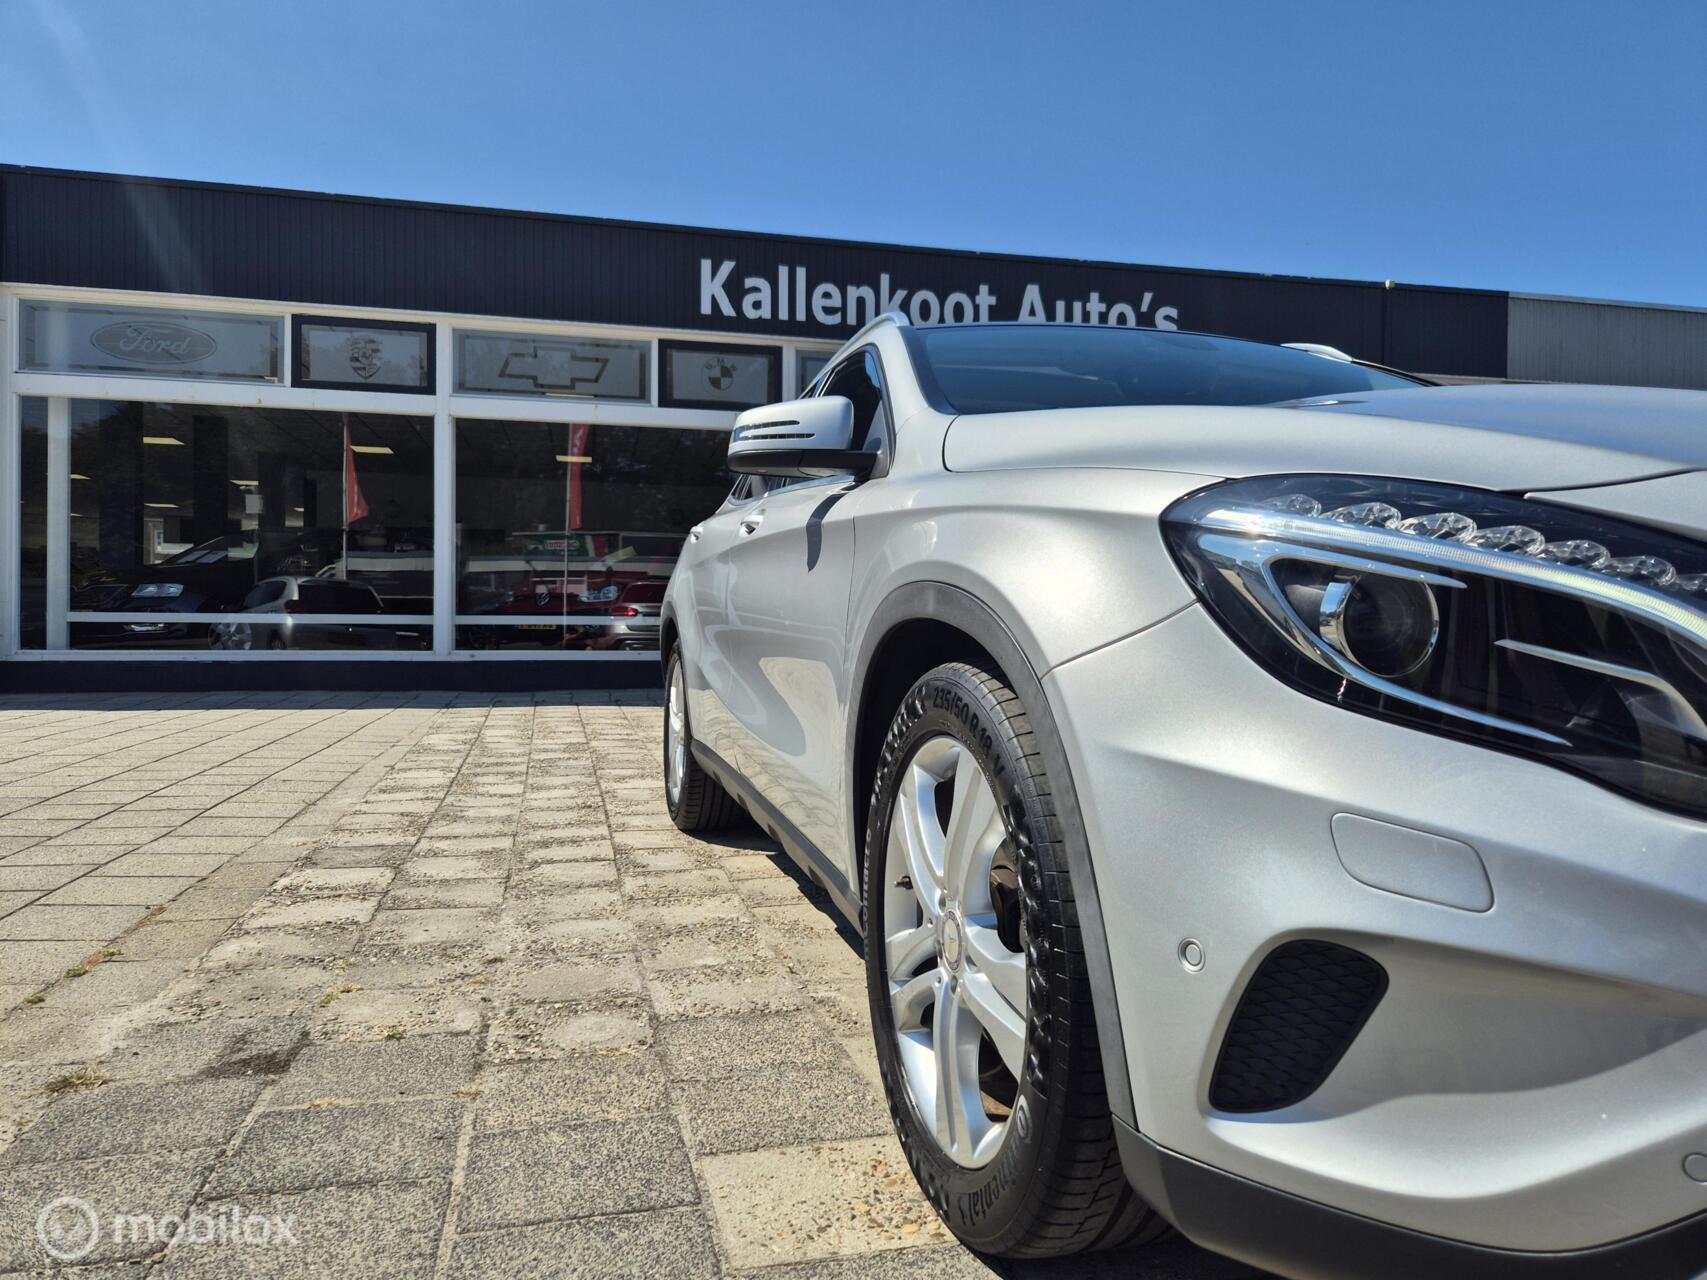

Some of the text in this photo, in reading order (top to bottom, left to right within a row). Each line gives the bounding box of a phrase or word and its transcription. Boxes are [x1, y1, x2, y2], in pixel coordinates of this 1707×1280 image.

[700, 258, 1180, 330] Kallenkoot Auto's
[119, 325, 192, 354] Ford
